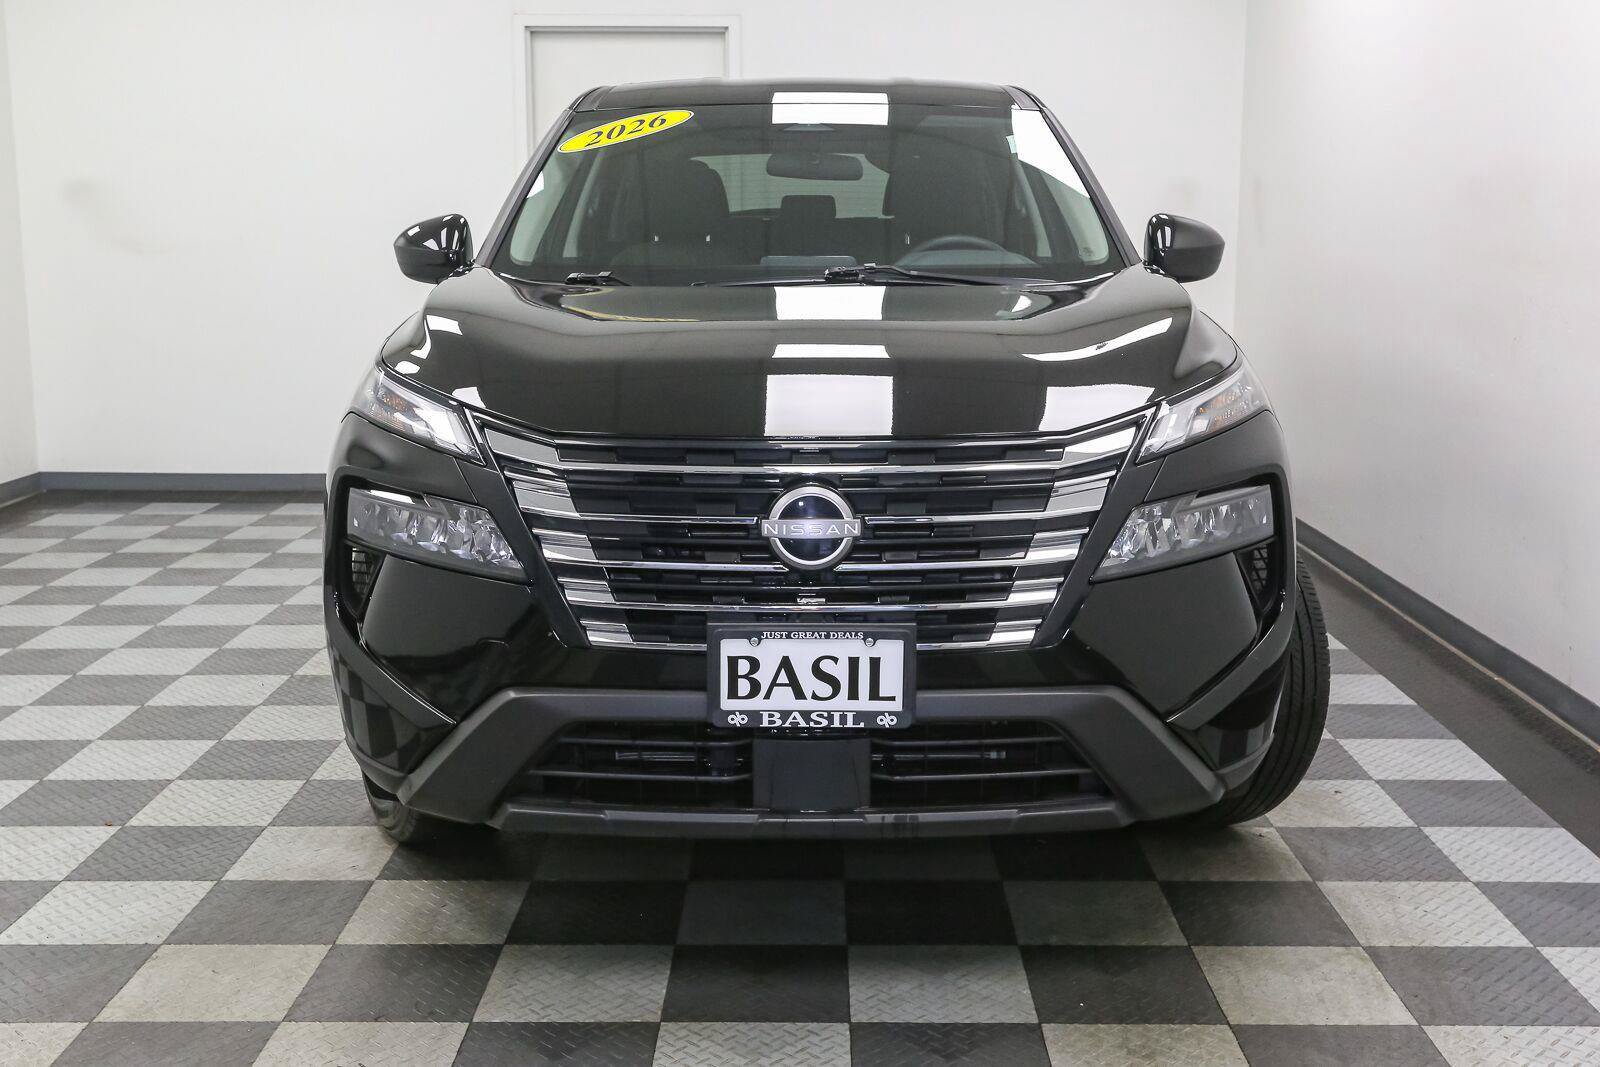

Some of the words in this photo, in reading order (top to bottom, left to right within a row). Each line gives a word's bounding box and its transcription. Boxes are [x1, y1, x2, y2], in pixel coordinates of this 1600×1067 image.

[584, 112, 667, 148] 2026
[764, 523, 859, 536] NISSAN
[761, 631, 788, 639] JUST
[791, 631, 827, 639] GREAT
[829, 632, 864, 640] DEALS
[727, 655, 896, 701] BASIL
[759, 711, 865, 728] BASIL
